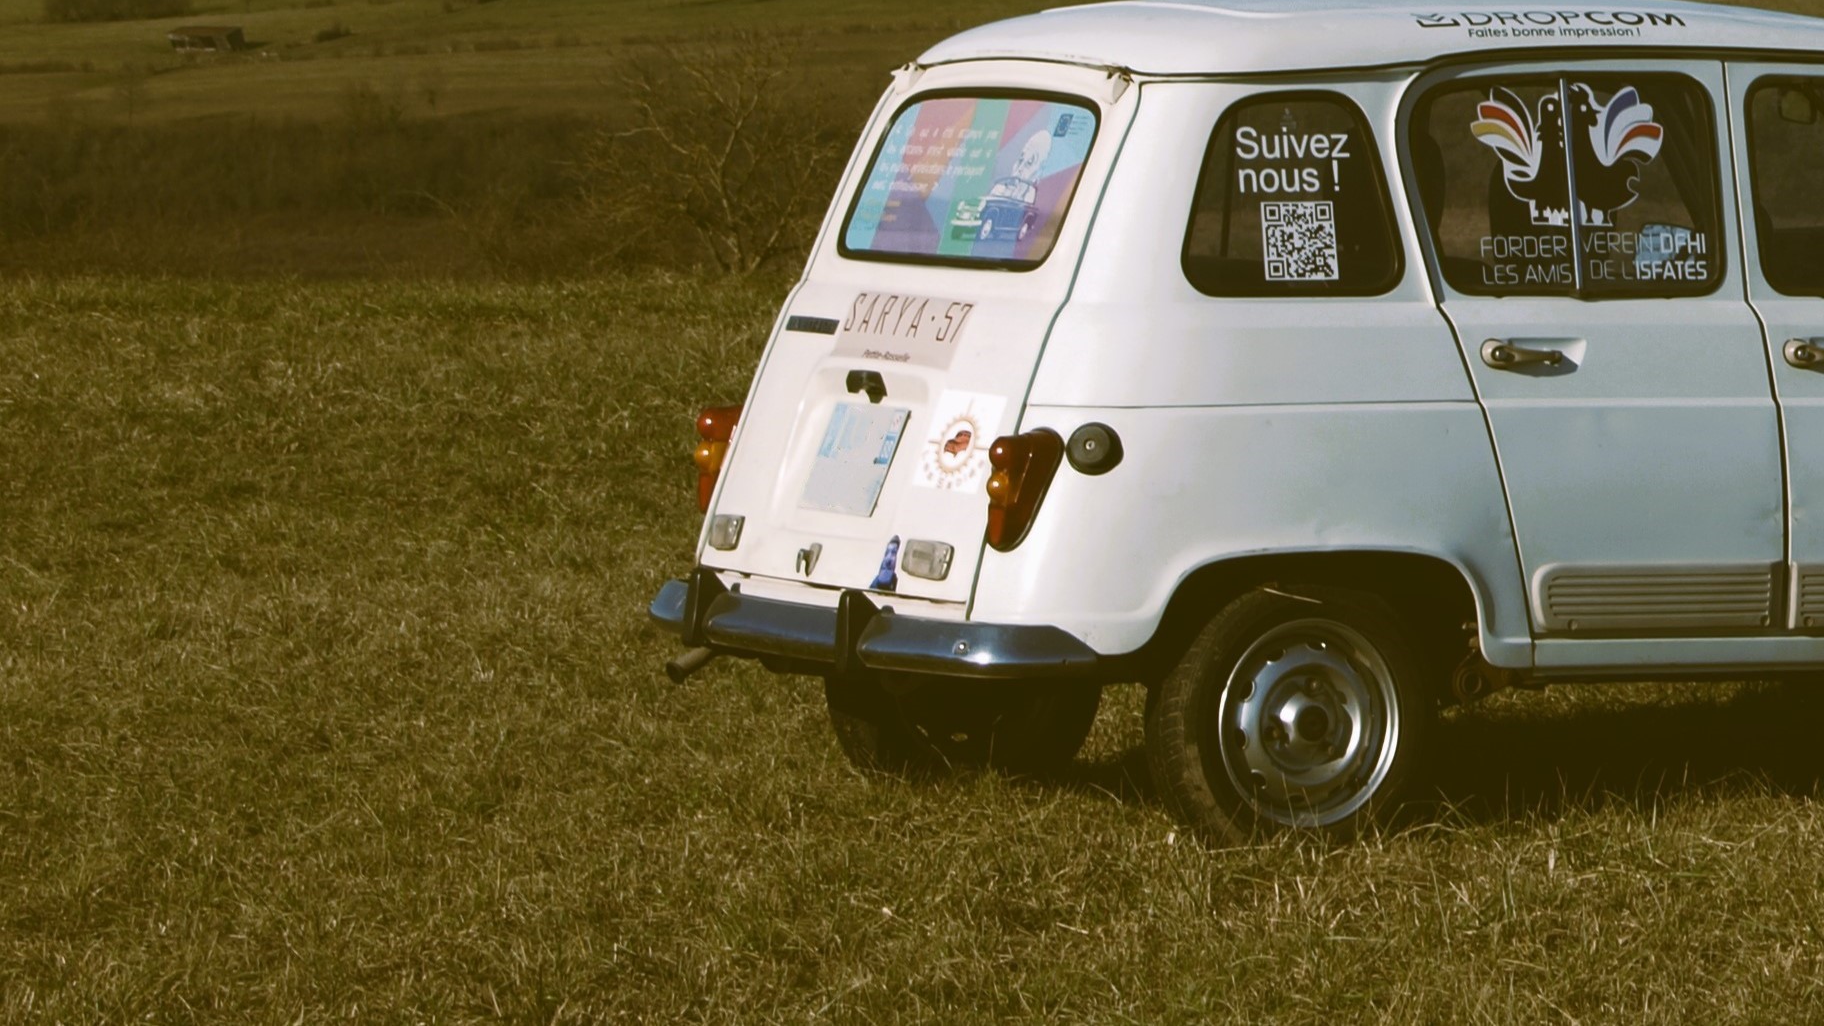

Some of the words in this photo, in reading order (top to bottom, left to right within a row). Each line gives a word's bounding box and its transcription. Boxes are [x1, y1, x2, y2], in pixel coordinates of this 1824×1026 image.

[1460, 10, 1687, 27] DROPCOM
[1467, 28, 1509, 39] Faites
[1512, 27, 1556, 38] bonne
[1558, 27, 1636, 39] impression
[1235, 126, 1351, 160] Suivez
[1238, 167, 1321, 194] nous
[1331, 159, 1340, 192] !
[1582, 231, 1653, 255] VEREIN
[1660, 232, 1707, 255] DFHI
[1482, 263, 1519, 285] LES
[1525, 263, 1573, 285] AMIS
[1590, 259, 1617, 281] DE
